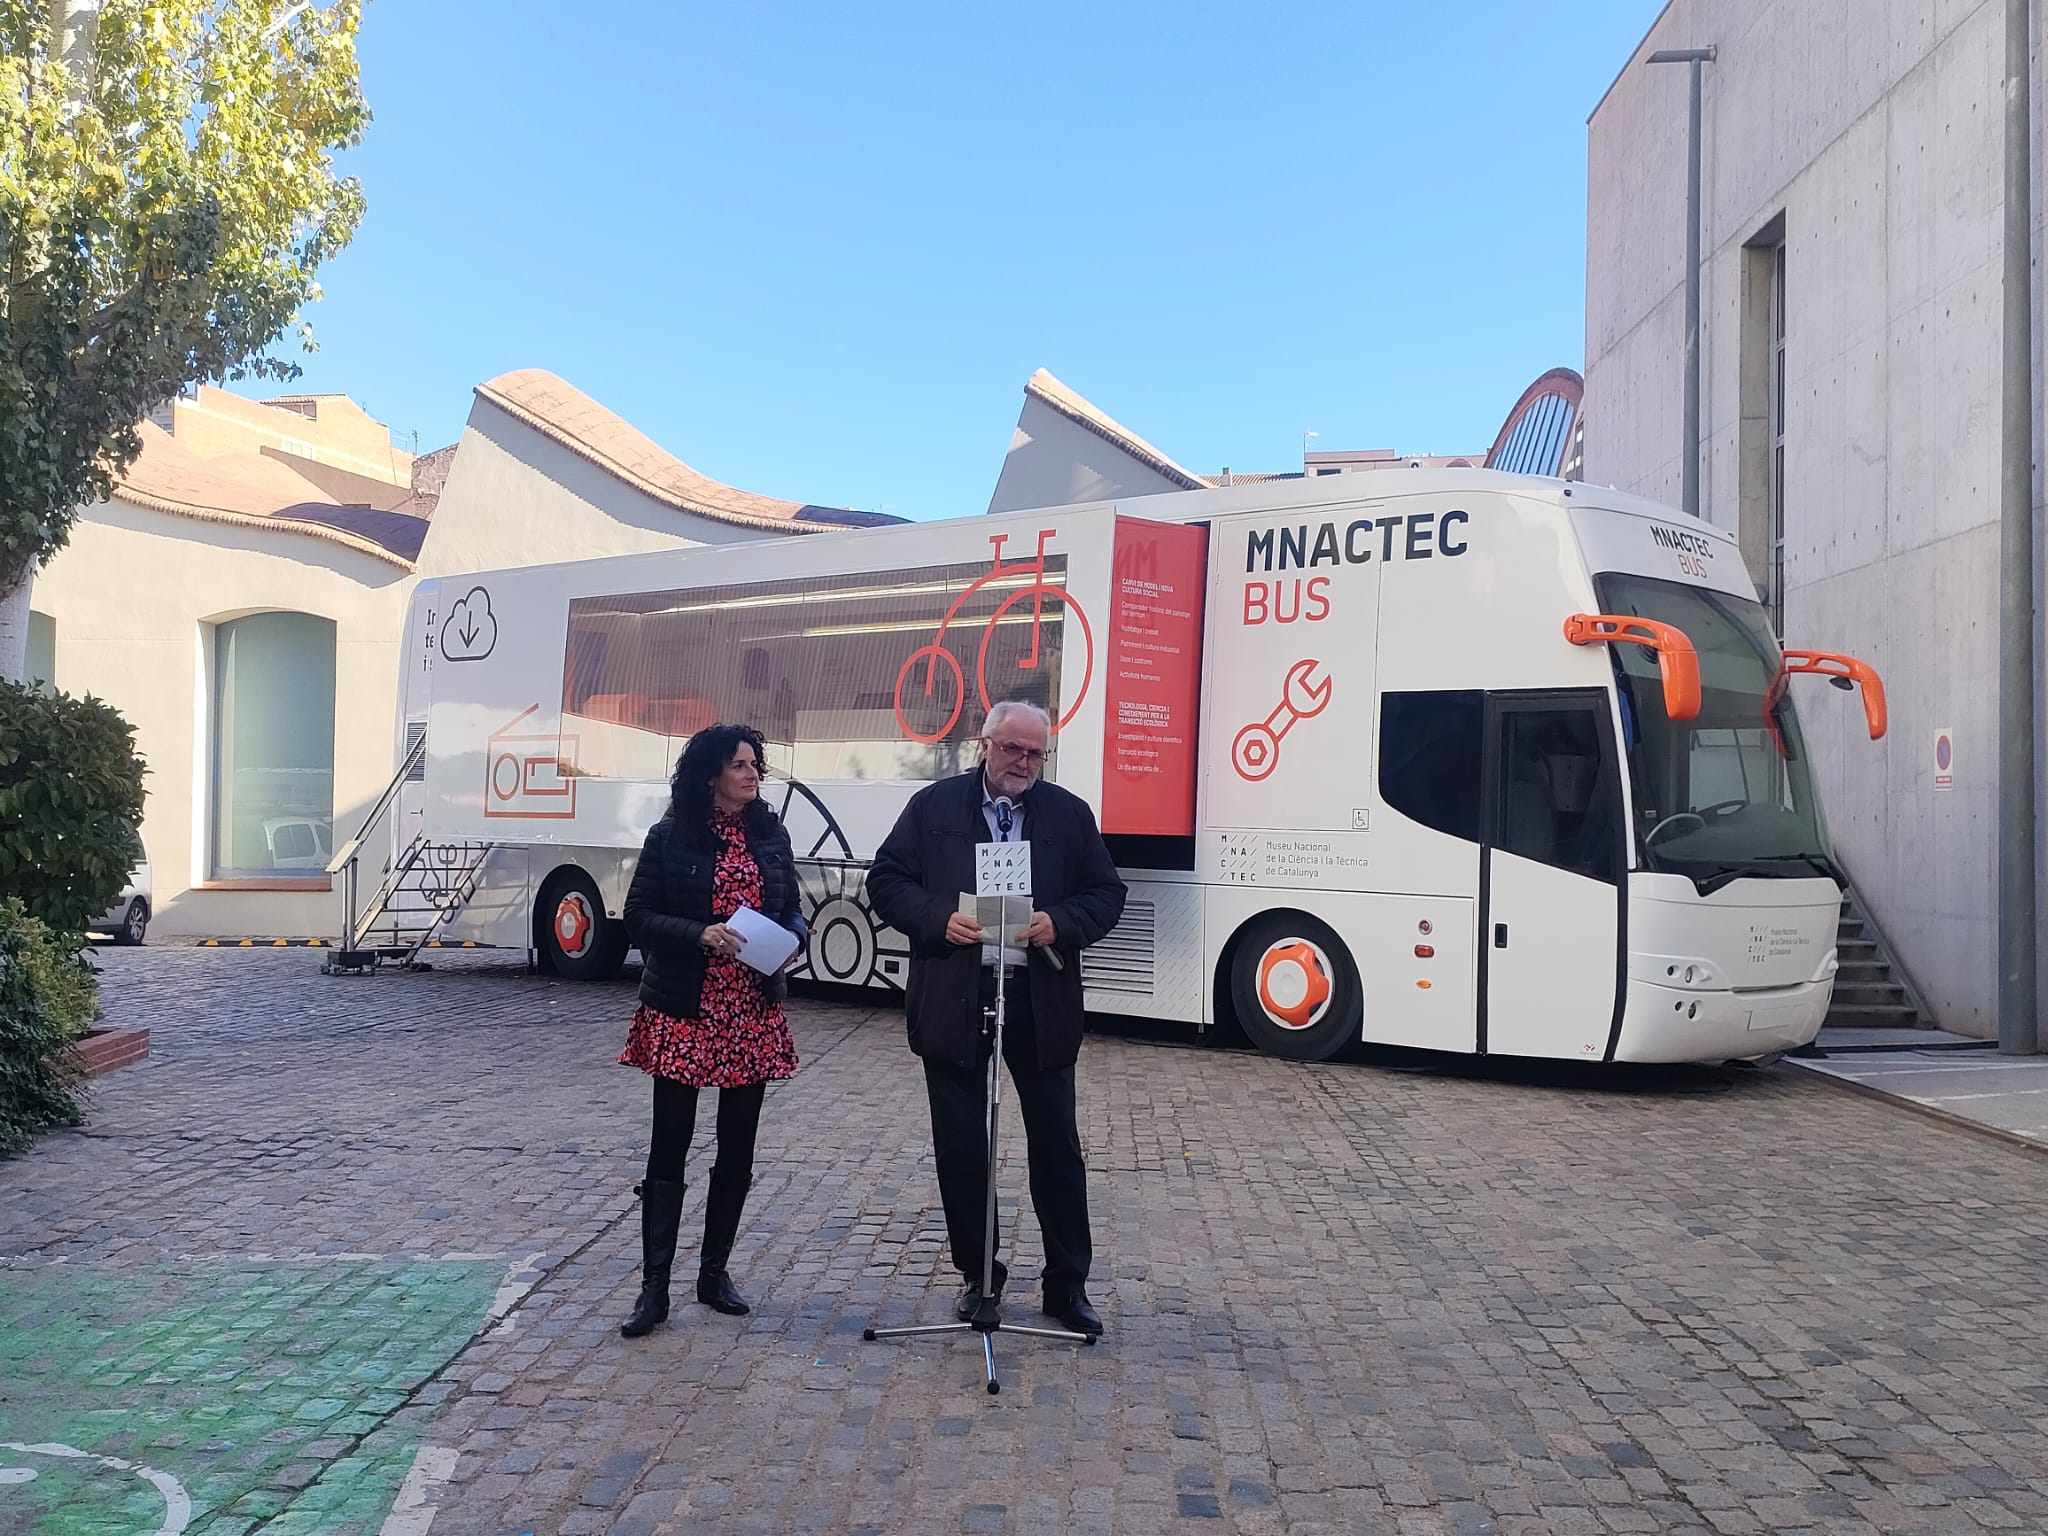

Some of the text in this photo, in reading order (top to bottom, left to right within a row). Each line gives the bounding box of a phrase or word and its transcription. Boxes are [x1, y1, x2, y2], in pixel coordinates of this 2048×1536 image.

[1246, 510, 1469, 573] MNACTEC
[1650, 525, 1714, 559] MNACTEC
[1678, 554, 1707, 578] BUS
[1243, 576, 1330, 625] BUS
[1266, 841, 1331, 852] Museu Nacional
[1278, 866, 1319, 878] Catalunya
